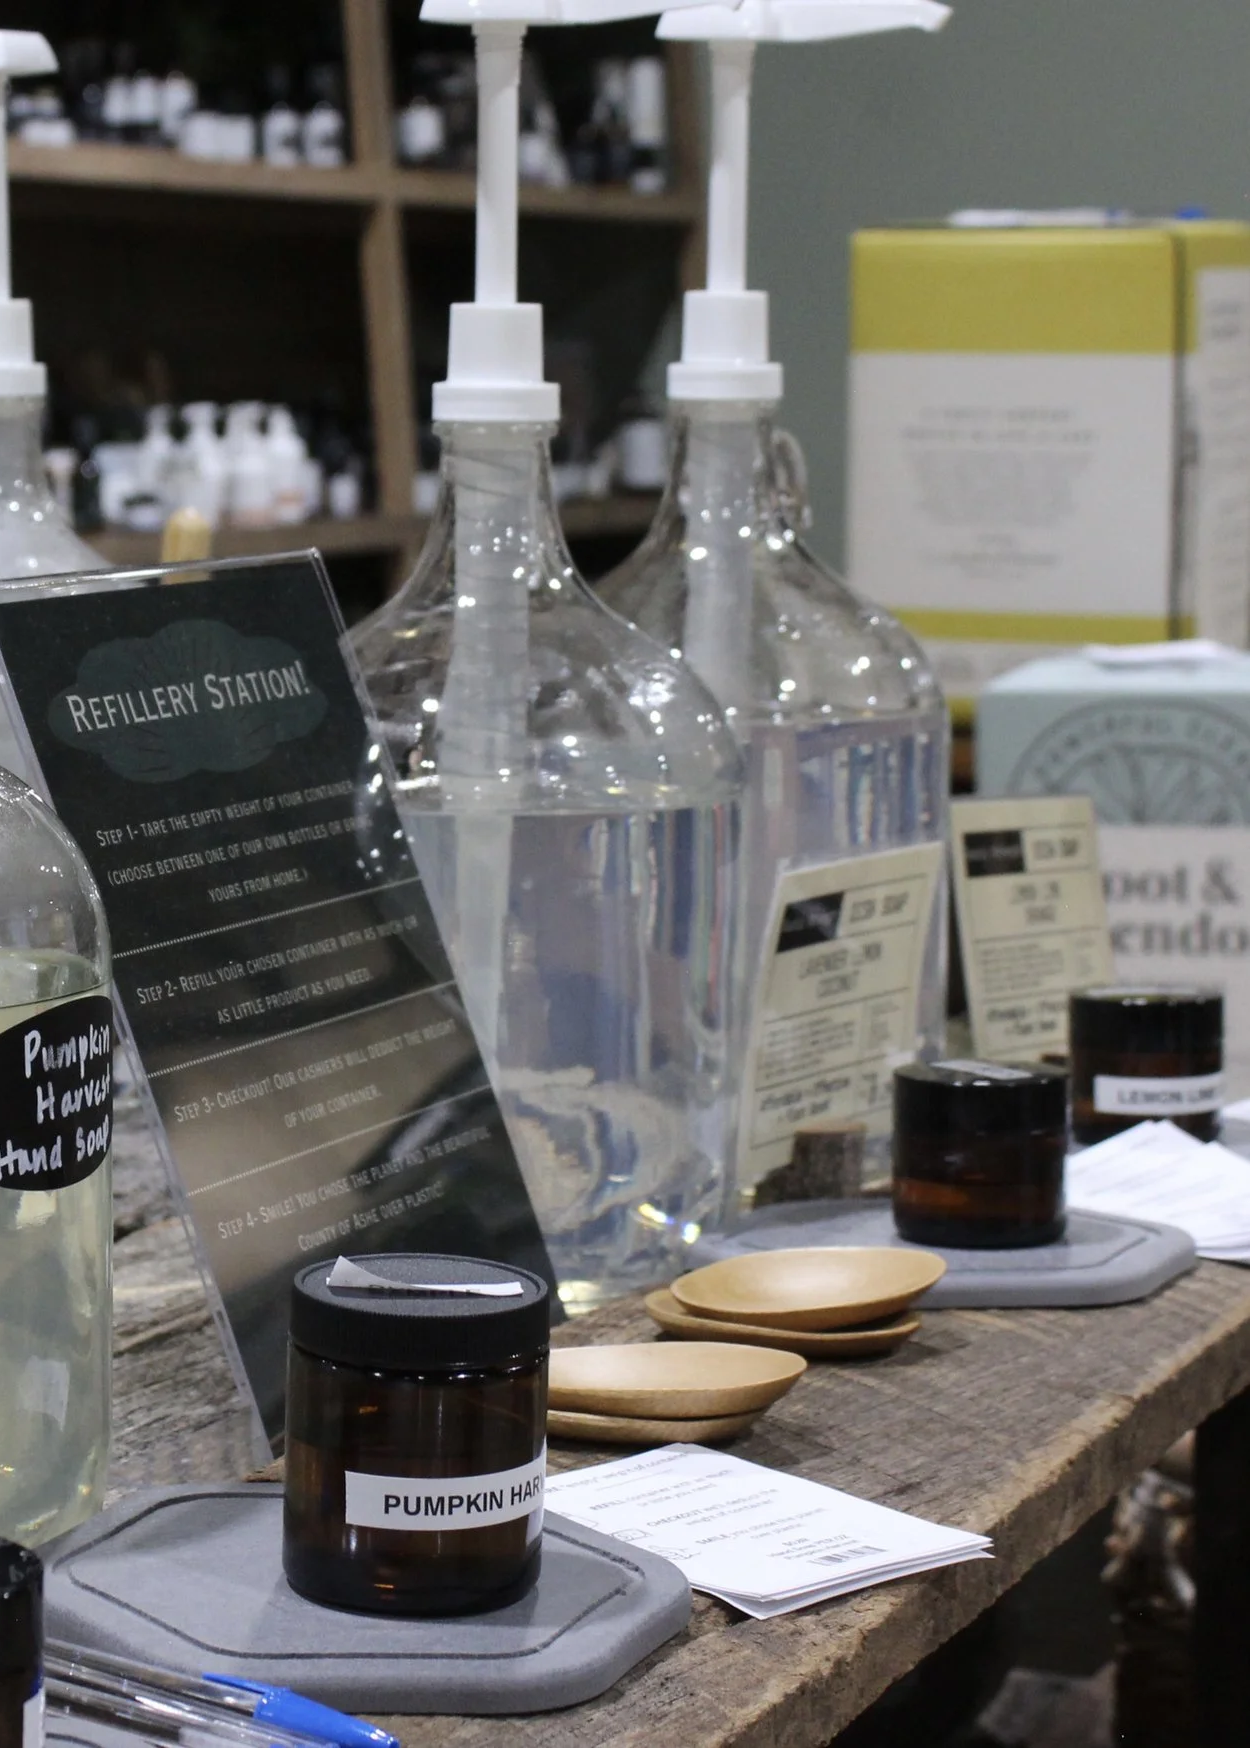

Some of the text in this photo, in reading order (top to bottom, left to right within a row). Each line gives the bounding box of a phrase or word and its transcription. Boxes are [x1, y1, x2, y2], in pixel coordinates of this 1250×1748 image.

[66, 660, 310, 733] REFILLERY STATION!
[96, 827, 124, 847] STEP
[140, 818, 169, 838] TARE
[168, 814, 191, 832] THE
[190, 807, 224, 827] EMPTY
[224, 798, 261, 819] WEIGHT
[262, 796, 277, 811] OF
[278, 790, 304, 808] YOUR
[107, 863, 155, 886] (CHOOSE
[155, 851, 206, 876] BETWEEN
[205, 847, 228, 864] ONE
[227, 843, 241, 859] OF
[241, 838, 265, 855] OUR
[264, 833, 287, 850] OWN
[288, 823, 329, 845] BOTTLES
[328, 821, 343, 836] OR
[1103, 865, 1189, 904] oot
[1200, 856, 1242, 904] &
[208, 882, 244, 903] YOURS
[243, 875, 272, 894] FROM
[136, 984, 163, 1004] STEP
[179, 971, 218, 993] REFILL
[216, 963, 247, 983] YOUR
[246, 951, 287, 975] CHOSEN
[286, 937, 338, 963] CONTAINER
[338, 931, 364, 948] WITH
[363, 926, 377, 941] AS
[216, 1008, 232, 1024] AS
[231, 998, 267, 1020] LITTLE
[265, 985, 310, 1010] PRODUCT
[310, 981, 325, 996] AS
[324, 975, 346, 993] YOU
[24, 1024, 110, 1079] Pumpkin
[174, 1101, 200, 1122] STEP
[273, 1071, 298, 1090] OUR
[297, 1056, 344, 1083] CASHIERS
[344, 1048, 369, 1067] WILL
[367, 1036, 404, 1060] DEDUCT
[403, 1029, 424, 1047] THE
[422, 1018, 457, 1042] WEIGHT
[36, 1062, 111, 1124] Harvest
[283, 1111, 298, 1129] OF
[298, 1102, 325, 1124] YOUR
[217, 1217, 244, 1240] STEP
[295, 1191, 318, 1209] YOU
[317, 1178, 351, 1202] CHOSE
[350, 1169, 372, 1189] THE
[370, 1157, 405, 1181] PLANET
[424, 1142, 445, 1160] THE
[297, 1225, 338, 1252] COUNTY
[337, 1219, 352, 1236] OF
[379, 1198, 406, 1220] OVER
[384, 1488, 504, 1517] PUMPKIN
